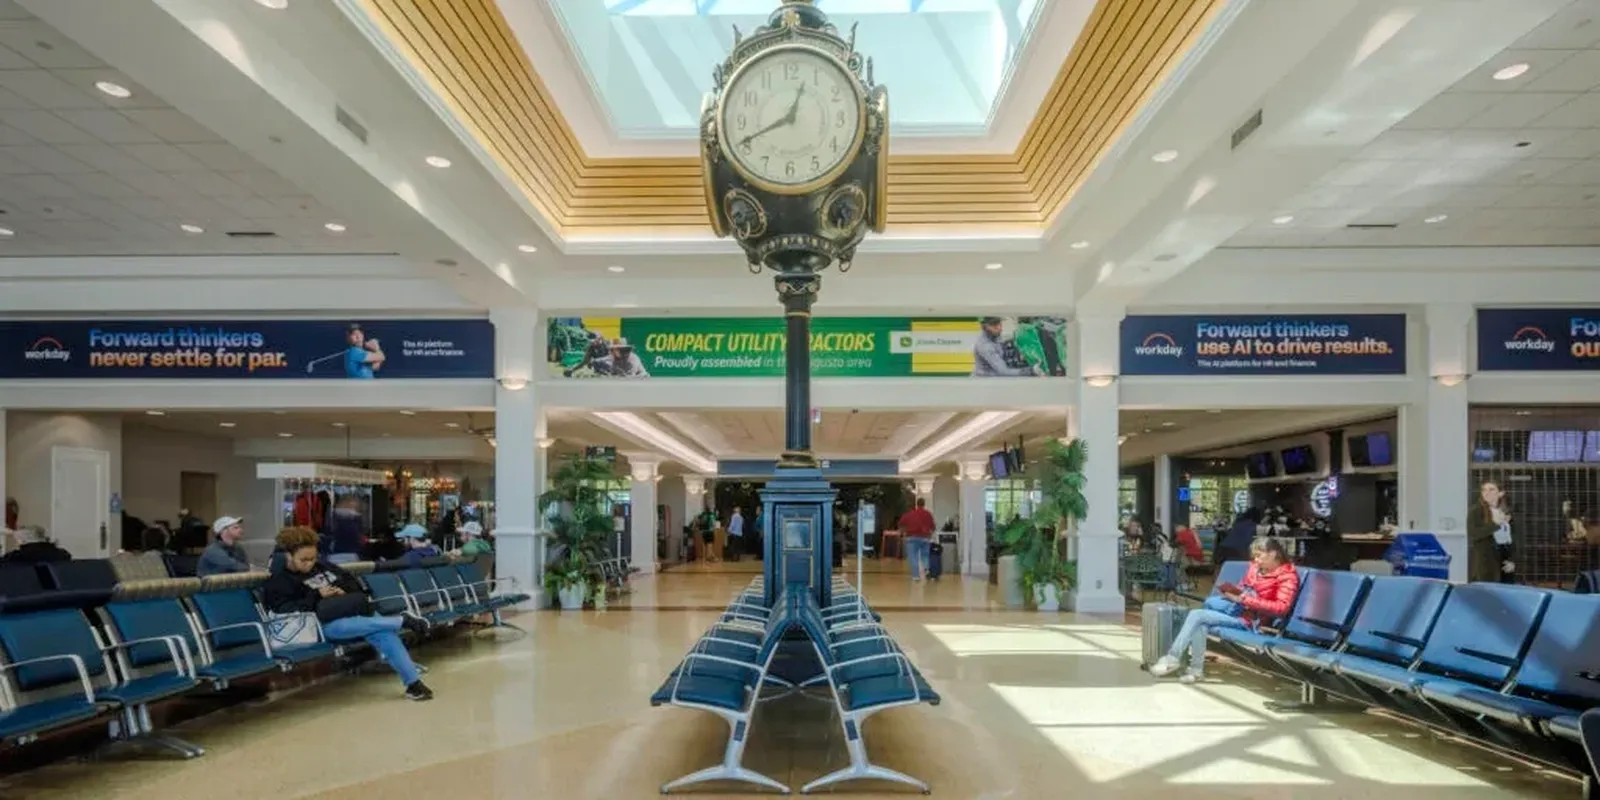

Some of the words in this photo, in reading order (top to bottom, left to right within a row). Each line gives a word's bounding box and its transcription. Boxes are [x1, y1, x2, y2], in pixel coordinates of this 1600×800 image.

[761, 70, 772, 90] 11
[784, 63, 799, 80] 12
[813, 68, 819, 86] 1
[744, 91, 758, 107] 10
[831, 86, 841, 102] 2
[737, 114, 746, 130] 9
[835, 111, 845, 128] 3
[829, 136, 837, 153] 4
[760, 155, 770, 172] 7
[785, 160, 795, 177] 6
[811, 155, 820, 172] 5
[1197, 321, 1272, 338] Forward
[1274, 320, 1350, 337] thinkers
[1571, 317, 1600, 337] Fo
[89, 328, 174, 347] Forward
[177, 327, 264, 347] thinkers
[645, 332, 725, 352] COMPACT
[727, 332, 786, 352] UTILITY
[808, 332, 875, 351] ACTORS
[1197, 341, 1231, 355] use
[1232, 339, 1251, 355] AI
[1254, 338, 1274, 355] to
[1276, 337, 1322, 355] drive
[1324, 336, 1393, 355] results.
[1504, 338, 1555, 352] workday
[24, 348, 70, 361] workday
[1135, 344, 1182, 357] workday
[90, 351, 148, 367] never
[150, 347, 213, 367] settle
[215, 347, 246, 367] for
[248, 351, 288, 372] par.
[654, 355, 700, 370] Proudly
[701, 356, 762, 368] assembled
